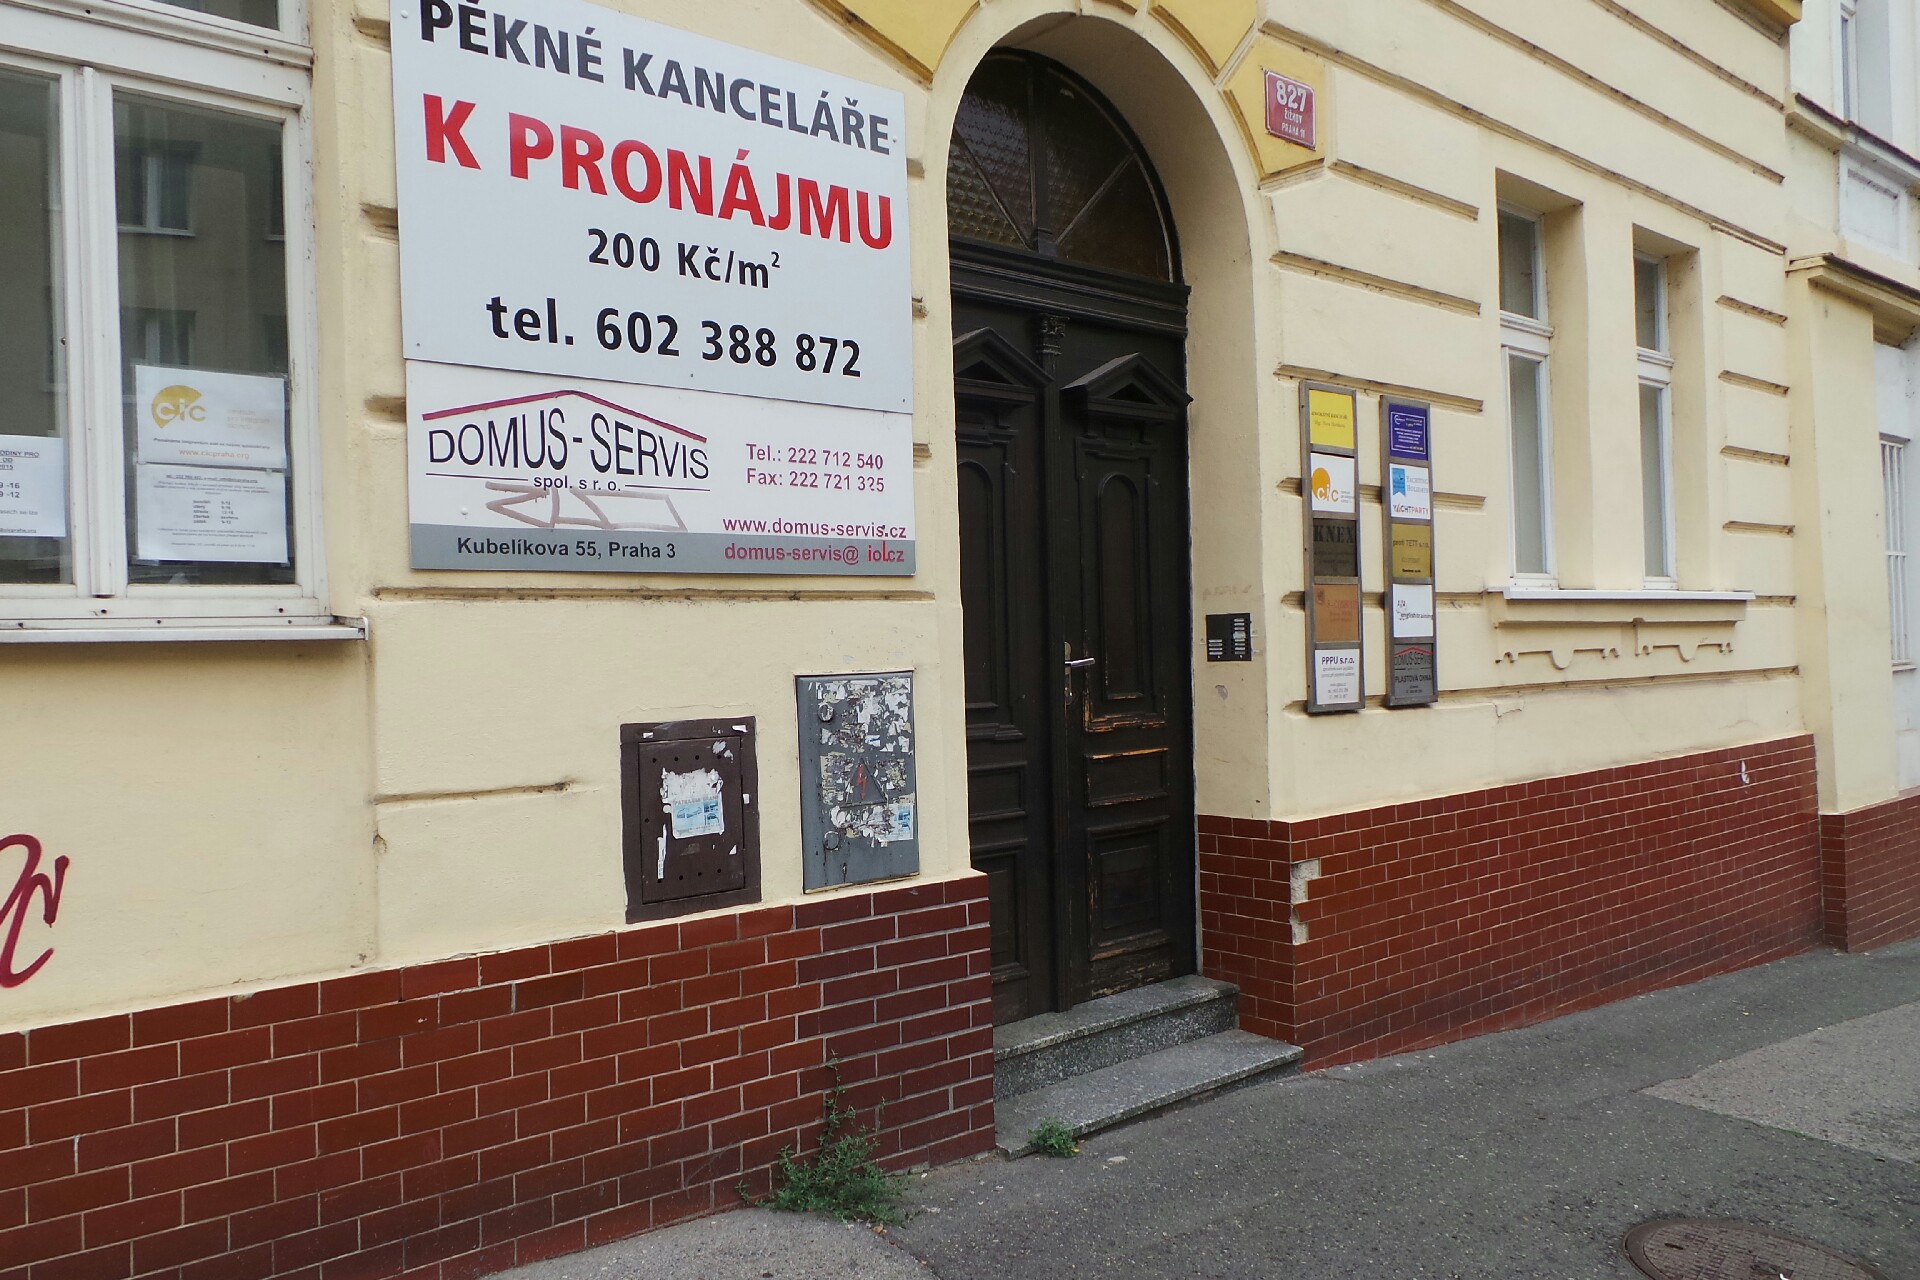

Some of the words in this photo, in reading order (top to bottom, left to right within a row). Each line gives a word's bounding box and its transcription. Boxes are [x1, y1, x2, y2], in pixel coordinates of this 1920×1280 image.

[420, 0, 604, 83] PĚKNÉ
[622, 46, 891, 156] KANCELÁŘE
[1276, 80, 1306, 112] 827
[423, 93, 482, 171] K
[508, 112, 893, 251] PRONÁJMU
[587, 228, 661, 272] 200
[486, 296, 574, 346] tel.
[596, 307, 680, 357] 602
[701, 320, 777, 367] 388
[795, 333, 861, 378] 872
[746, 444, 781, 462] Tel.:
[788, 447, 817, 465] 222
[822, 450, 851, 467] 712
[857, 453, 884, 470] 540
[533, 475, 573, 491] spol.
[607, 481, 622, 492] o.
[746, 468, 783, 486] Fax:
[789, 471, 819, 488] 222
[824, 473, 850, 490] 721
[723, 517, 907, 539] www.domus-servis.cz
[457, 537, 569, 556] Kubelíkova
[576, 541, 602, 559] 55,
[609, 542, 661, 557] Praha
[667, 543, 676, 558] 3
